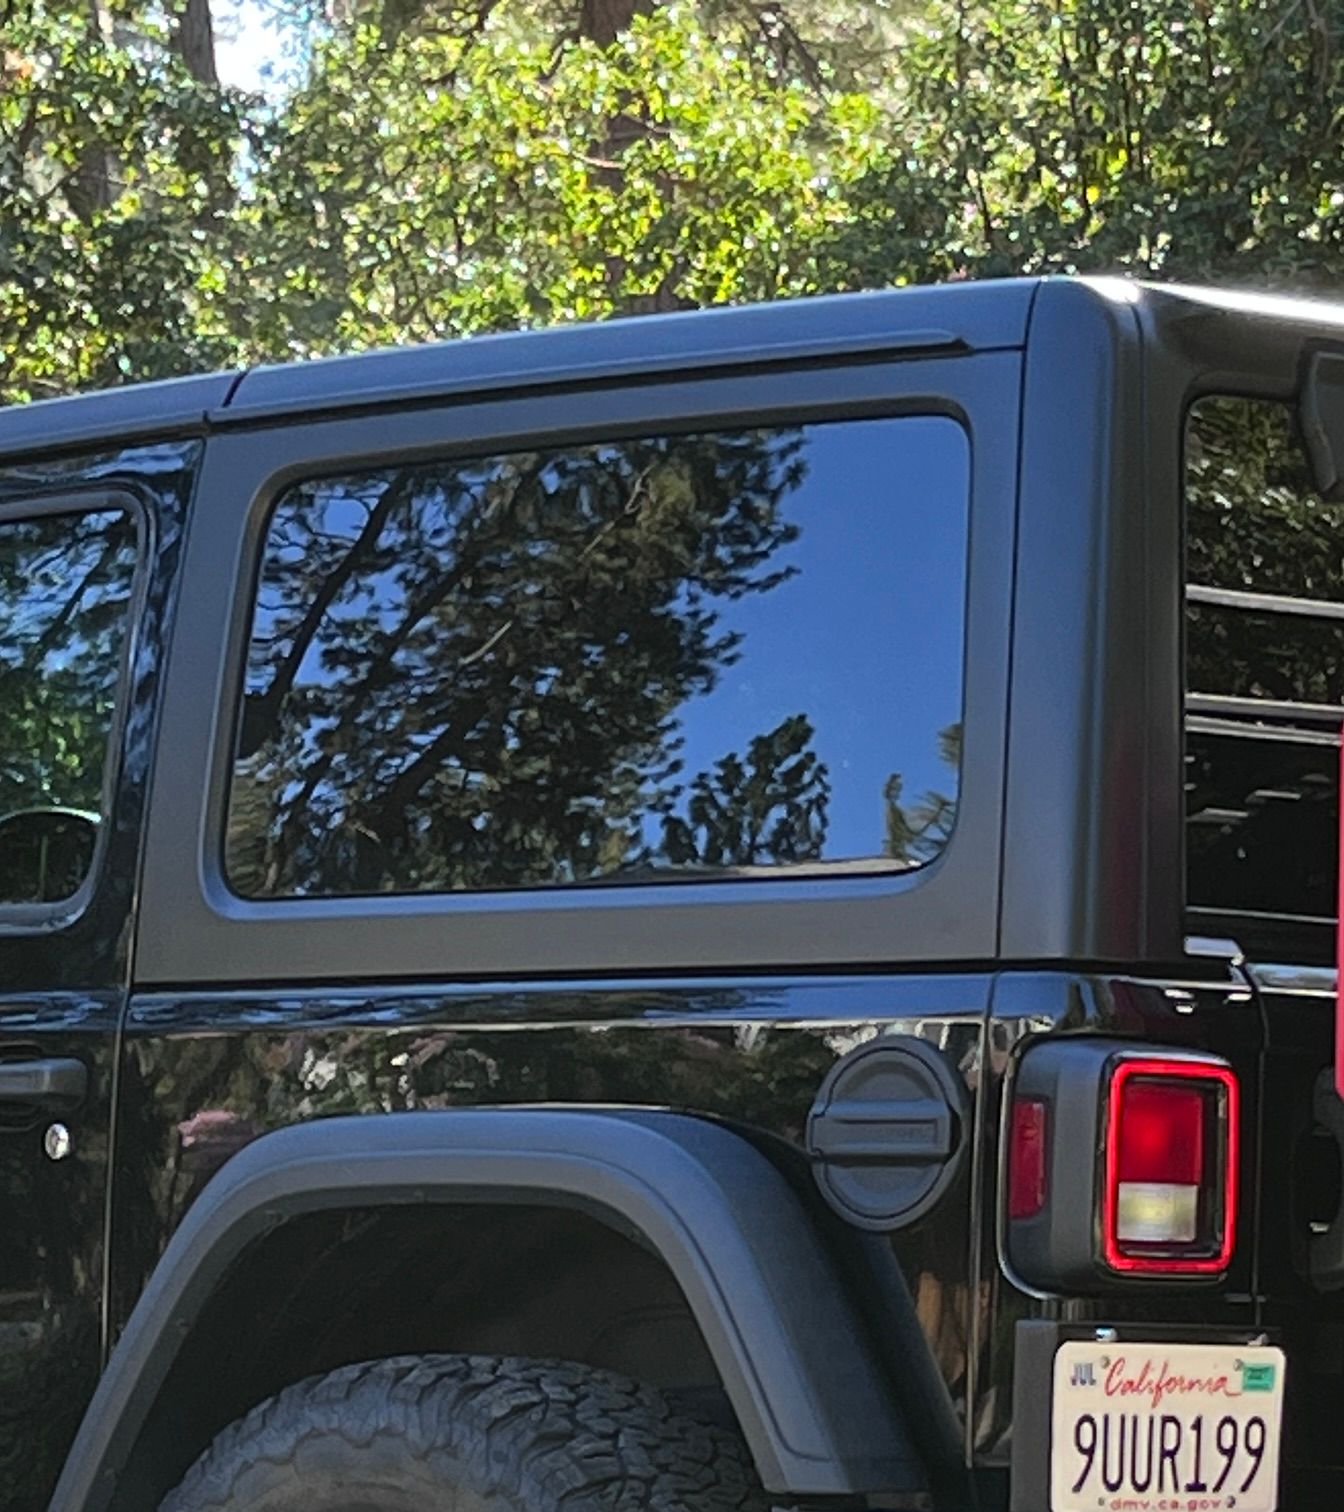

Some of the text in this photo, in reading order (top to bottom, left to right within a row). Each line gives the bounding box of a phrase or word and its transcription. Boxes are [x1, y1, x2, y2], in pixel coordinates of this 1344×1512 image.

[1104, 1356, 1243, 1408] California
[1072, 1413, 1267, 1493] 9UUR199
[1110, 1498, 1222, 1512] dmv.ca.gov
